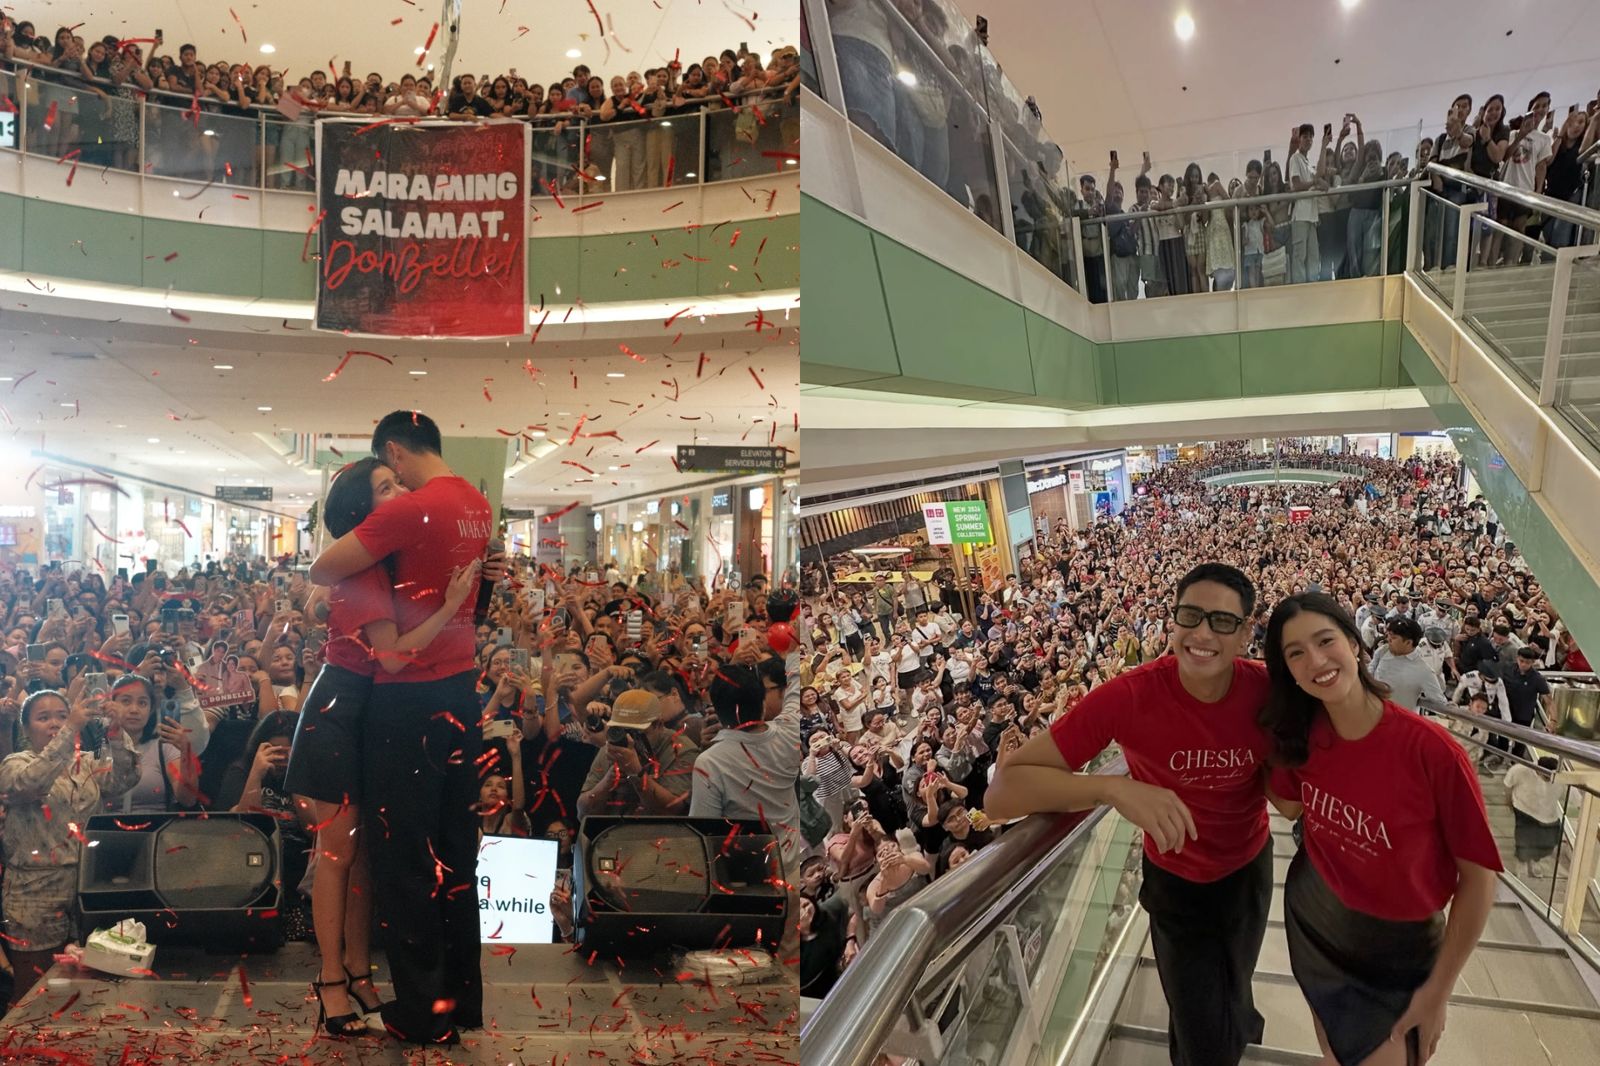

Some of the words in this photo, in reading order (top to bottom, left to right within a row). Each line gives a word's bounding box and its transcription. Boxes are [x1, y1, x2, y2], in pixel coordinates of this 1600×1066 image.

[334, 169, 518, 201] MARAMING
[340, 206, 510, 242] SALAMAT,
[740, 449, 772, 457] ELEVATOR
[724, 459, 755, 467] SERVICES
[954, 513, 982, 522] SPRING/
[955, 522, 985, 531] SUMMER
[209, 690, 252, 702] DONBELLE
[1169, 748, 1255, 771] CHESKA
[1301, 781, 1393, 849] CHESKA
[495, 897, 545, 914] while
